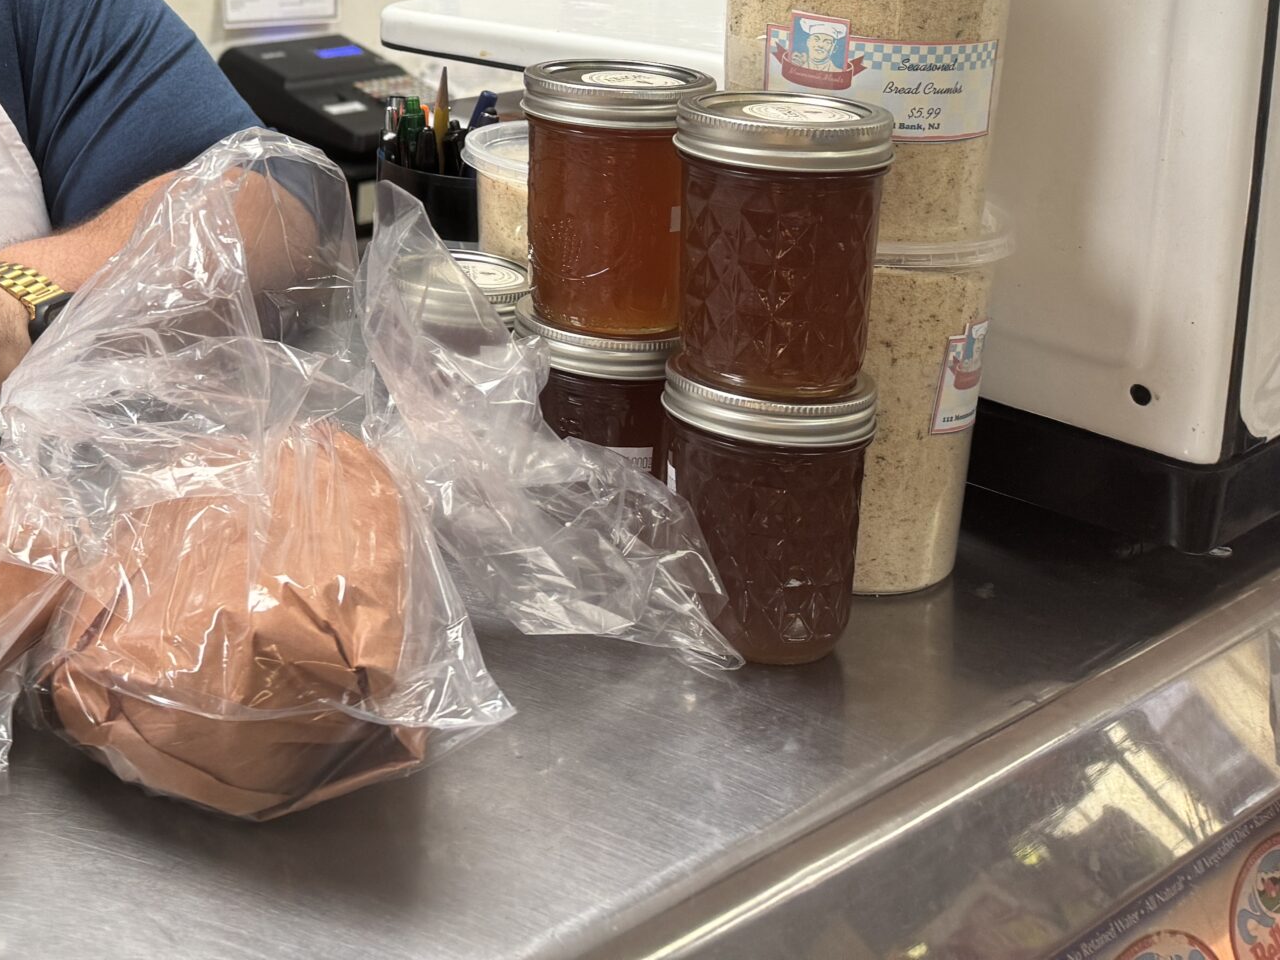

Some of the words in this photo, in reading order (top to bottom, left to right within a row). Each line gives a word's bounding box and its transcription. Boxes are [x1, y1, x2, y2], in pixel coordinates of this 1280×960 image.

[883, 81, 921, 95] Bread
[922, 82, 963, 96] Crumbs
[907, 107, 942, 120] $5.99
[898, 123, 926, 132] Bank,
[927, 123, 940, 131] NJ
